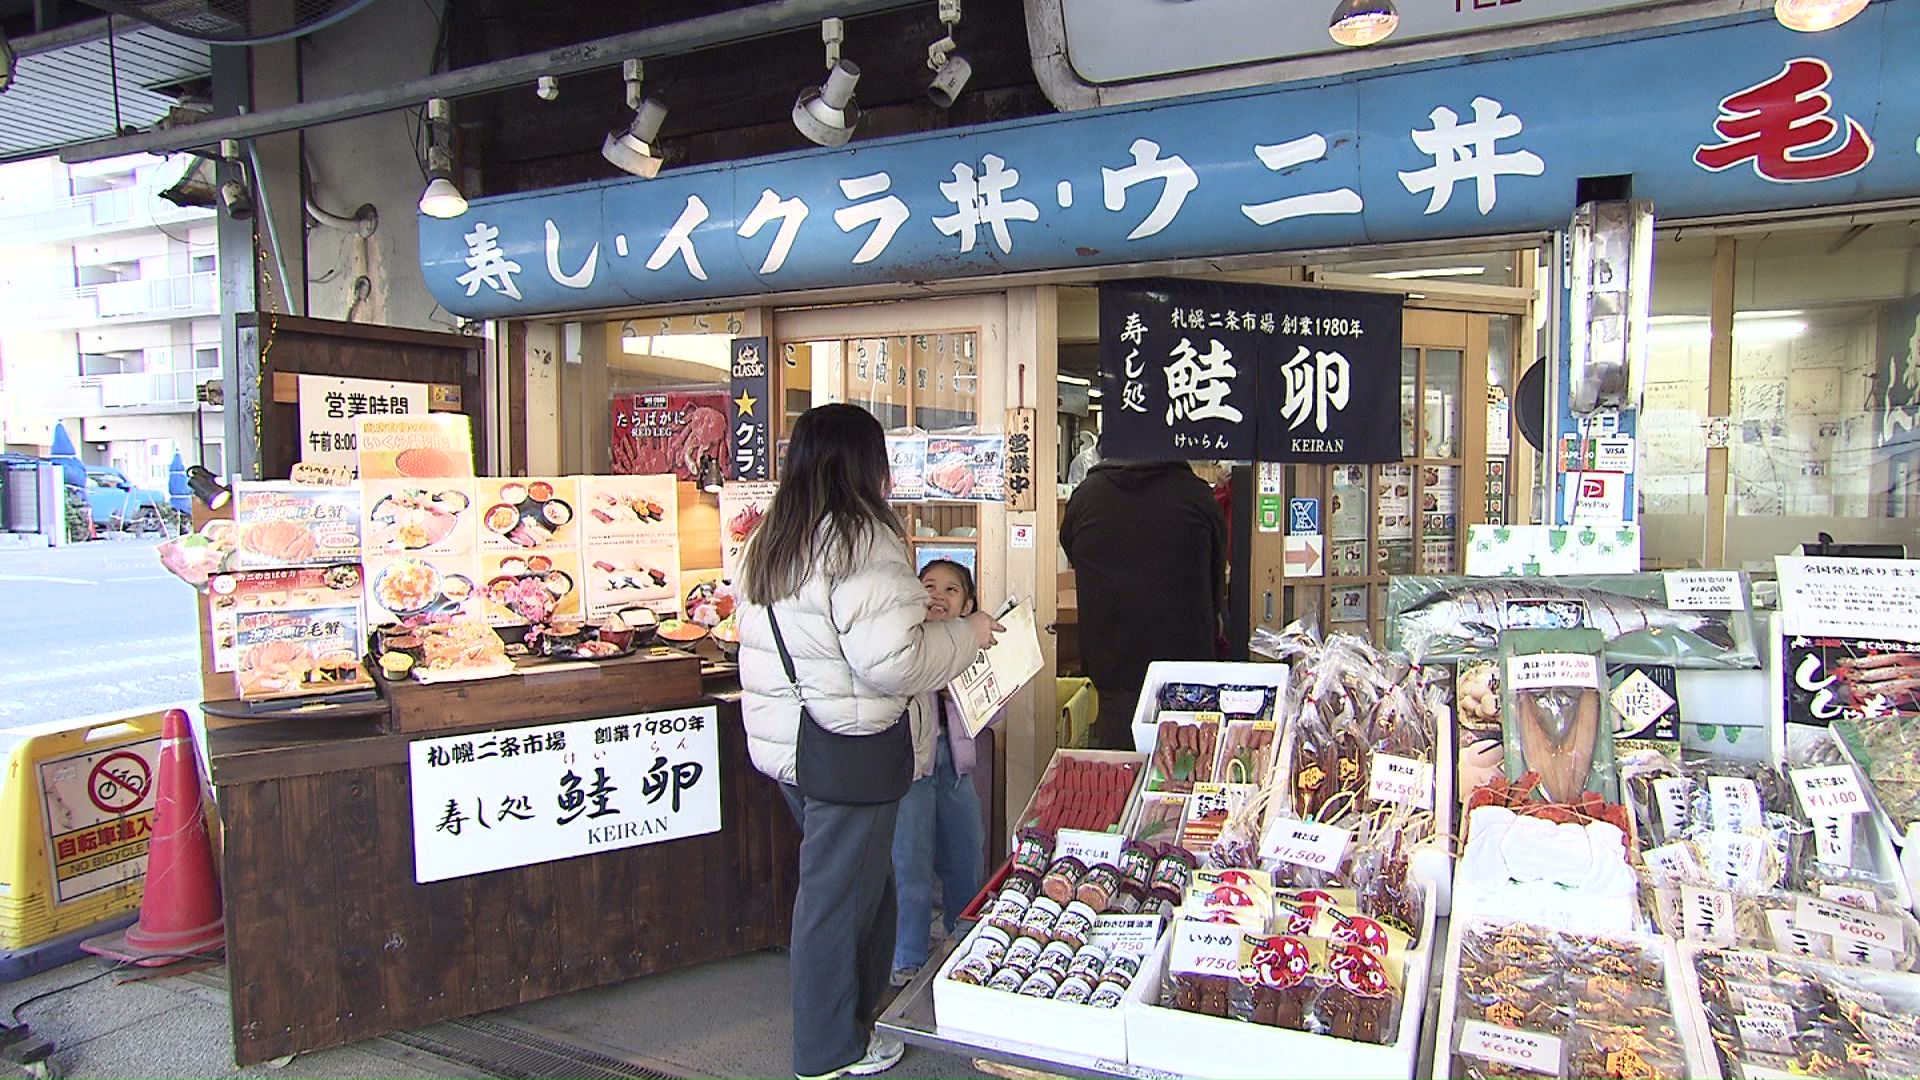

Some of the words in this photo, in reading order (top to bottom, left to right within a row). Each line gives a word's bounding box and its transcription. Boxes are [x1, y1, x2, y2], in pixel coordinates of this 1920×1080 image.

[1693, 57, 1875, 183] 毛
[1171, 307, 1275, 335] 札幌二条市場
[1282, 314, 1364, 339] 創業1980年
[732, 363, 765, 378] CLASSIC
[1120, 312, 1149, 413] 寿し処
[1163, 337, 1351, 434] 鮭卵
[325, 391, 409, 419] 営業時間
[616, 411, 687, 428] たらばがに
[631, 427, 652, 438] RED
[654, 427, 673, 438] LEG
[1174, 434, 1230, 450] けいらん
[1291, 438, 1345, 453] KEIRAN
[1604, 447, 1626, 455] VISA
[1009, 433, 1031, 494] 営業中
[427, 730, 566, 768] 札幌二条市場
[594, 714, 705, 744] 創業1980年
[1388, 763, 1414, 775] 鮭とば
[1375, 781, 1425, 798] ¥2,500
[1807, 791, 1857, 807] ¥1,100
[436, 795, 536, 837] 寿し処
[587, 816, 669, 845] KEIRAN
[1292, 831, 1320, 842] 鮭とば
[70, 860, 90, 874] NO
[92, 843, 144, 867] BICYCLE
[1271, 844, 1326, 864] ¥1,500
[1839, 922, 1885, 941] ¥600
[1194, 955, 1237, 970] ¥750
